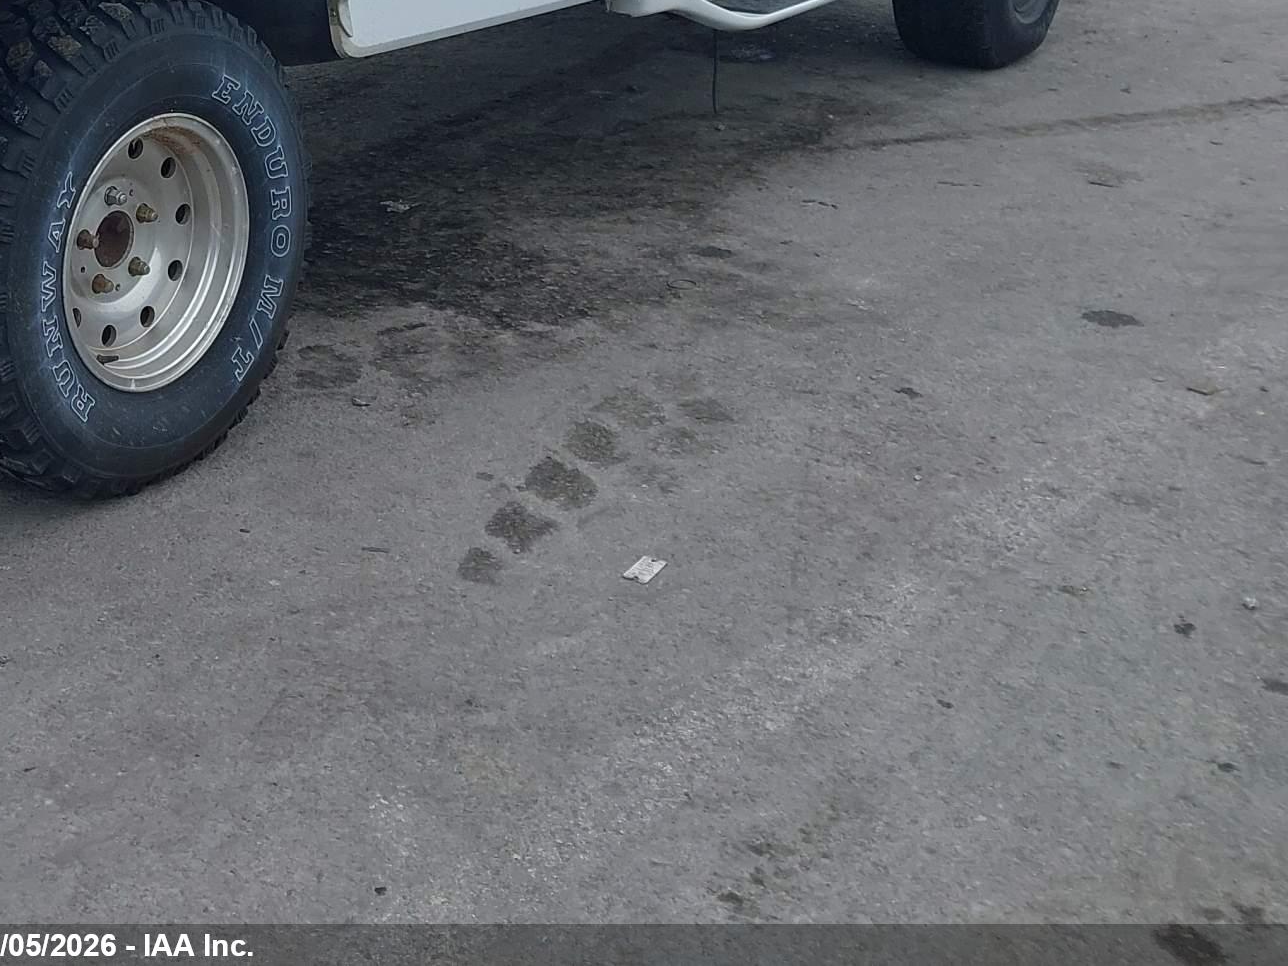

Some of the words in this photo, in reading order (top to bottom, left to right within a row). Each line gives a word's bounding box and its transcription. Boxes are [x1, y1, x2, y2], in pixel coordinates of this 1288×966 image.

[211, 73, 292, 258] ENDURO
[40, 171, 96, 423] RUNWAY
[231, 274, 284, 383] M/T
